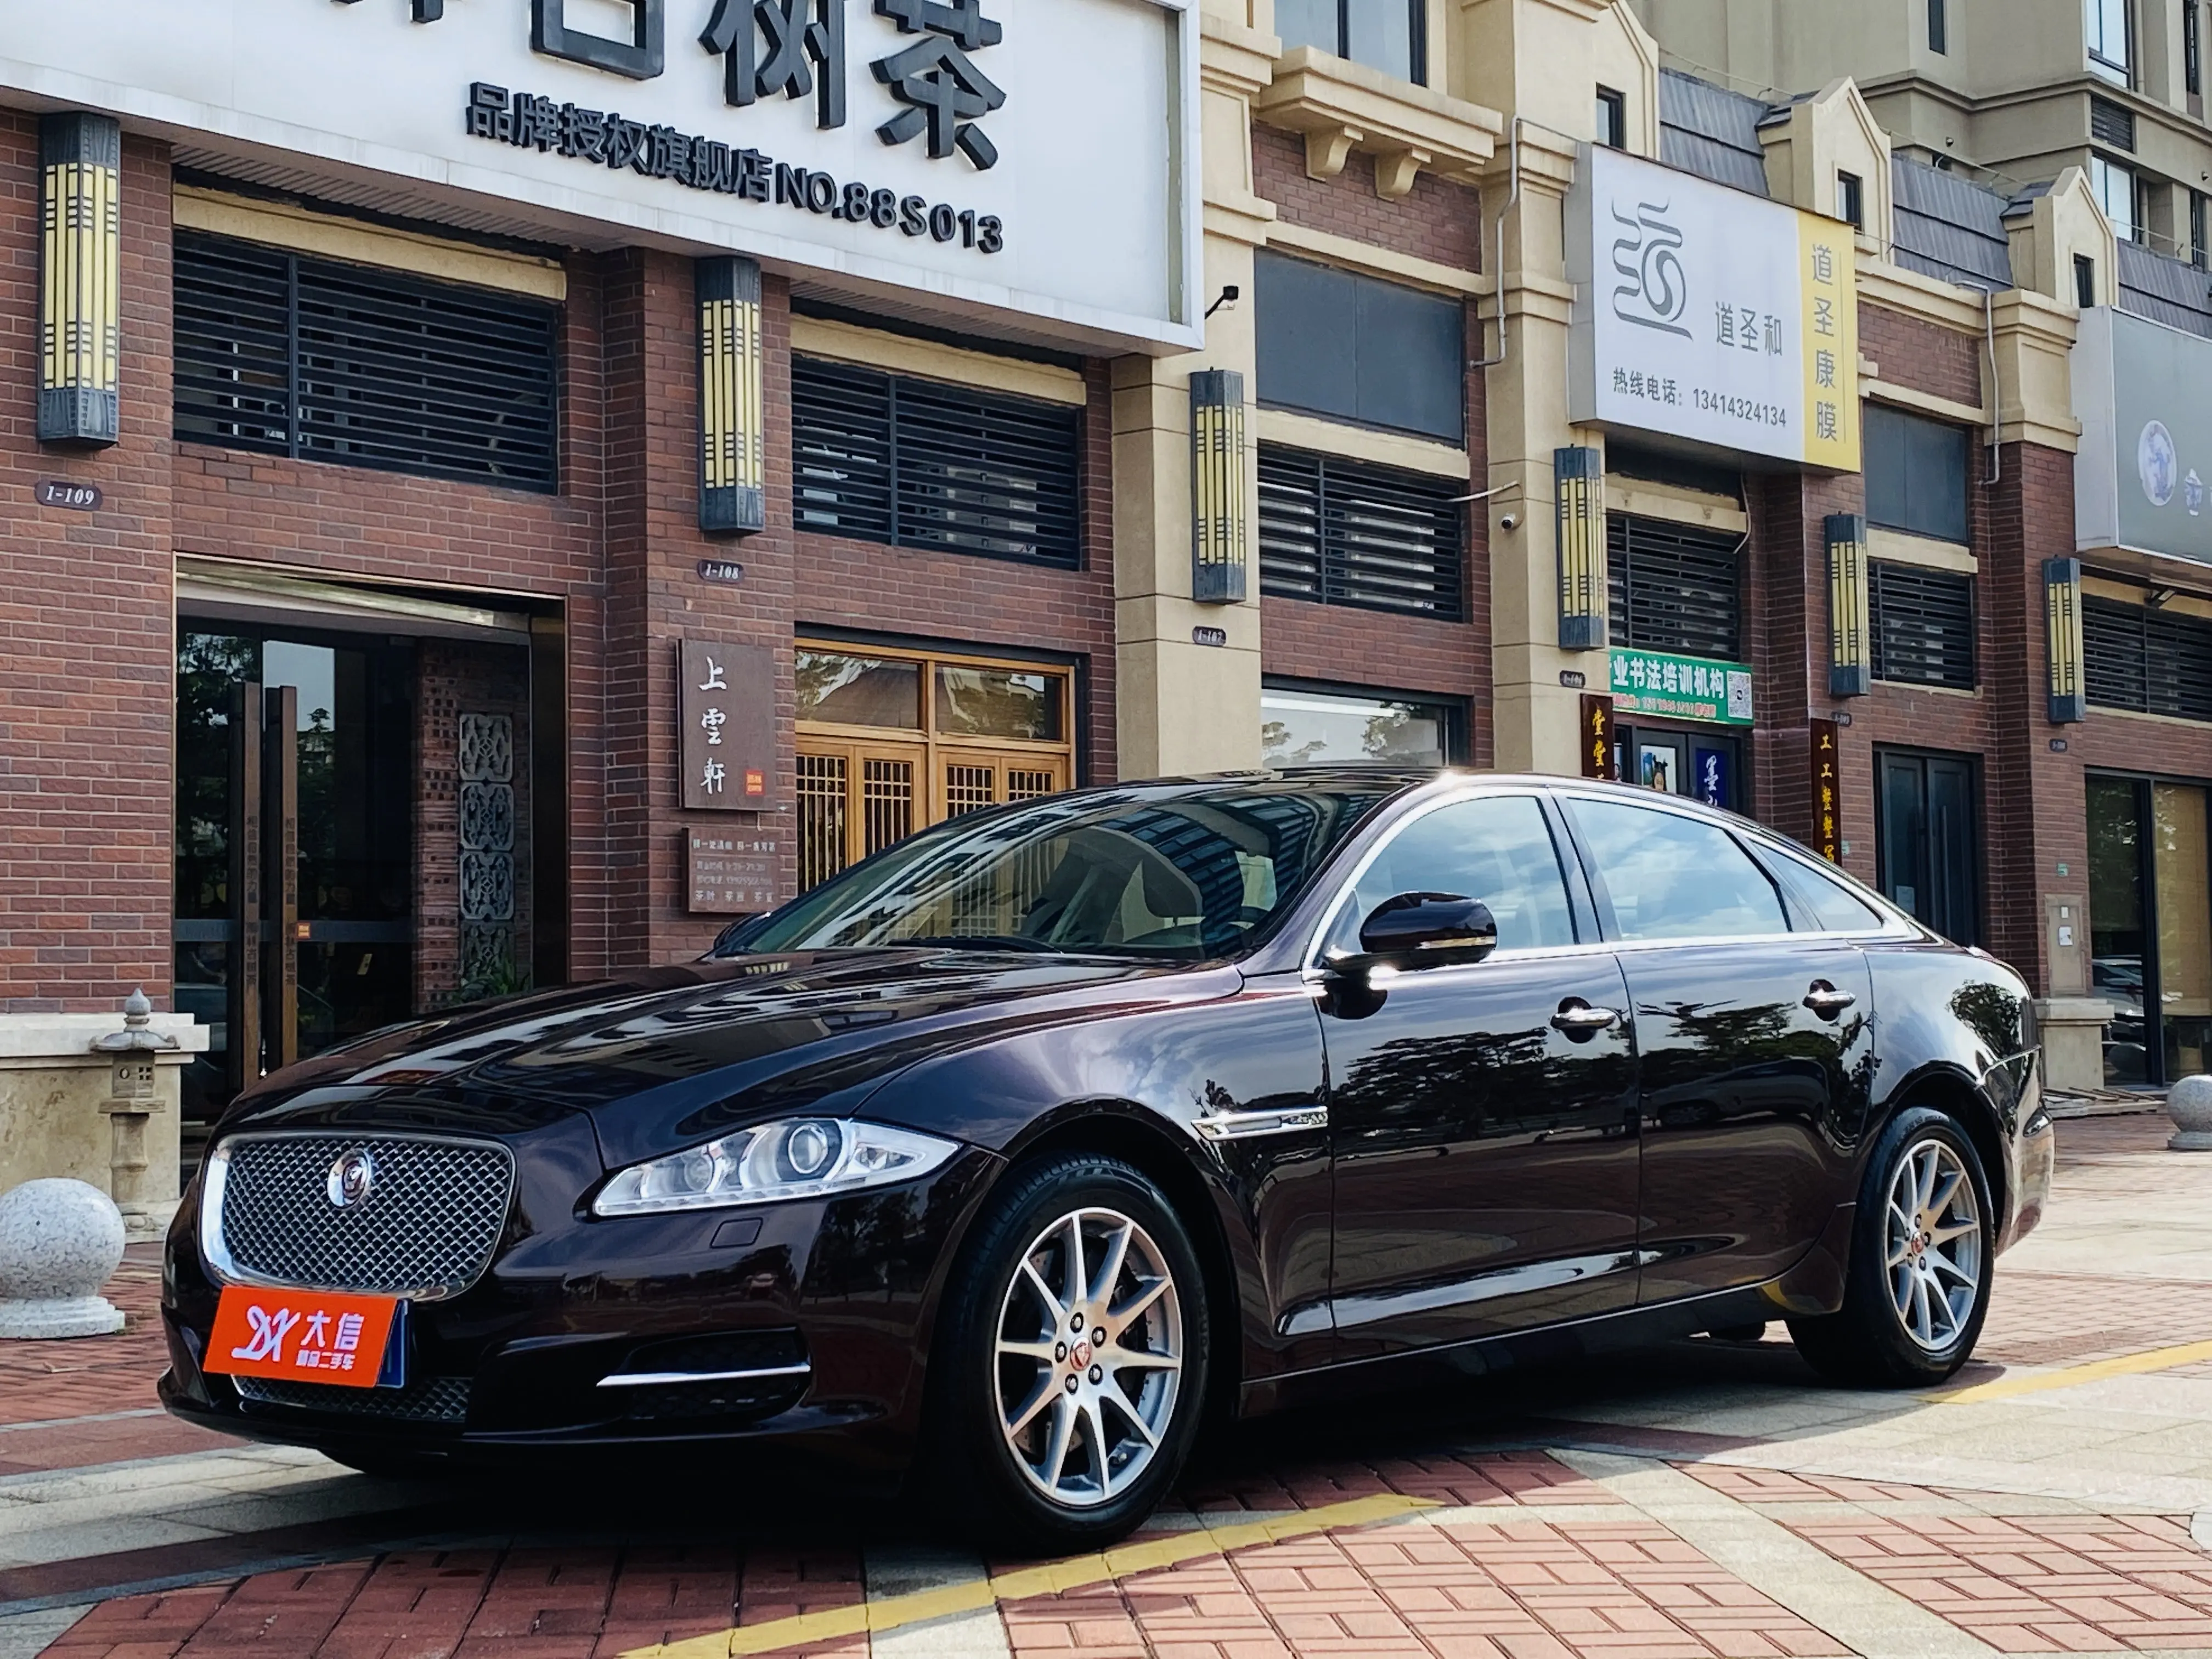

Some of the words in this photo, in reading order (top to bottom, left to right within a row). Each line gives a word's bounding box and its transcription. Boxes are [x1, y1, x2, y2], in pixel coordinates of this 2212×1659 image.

[410, 0, 1006, 171] 树茶
[1715, 300, 1783, 357] 道圣和
[1811, 243, 1838, 442] 道圣康膜
[46, 486, 94, 505] 1-109
[706, 563, 739, 579] 1-108
[1609, 654, 1724, 699] 业书法培训机构
[1592, 704, 1606, 779] 堂堂
[300, 1310, 365, 1351] 大信
